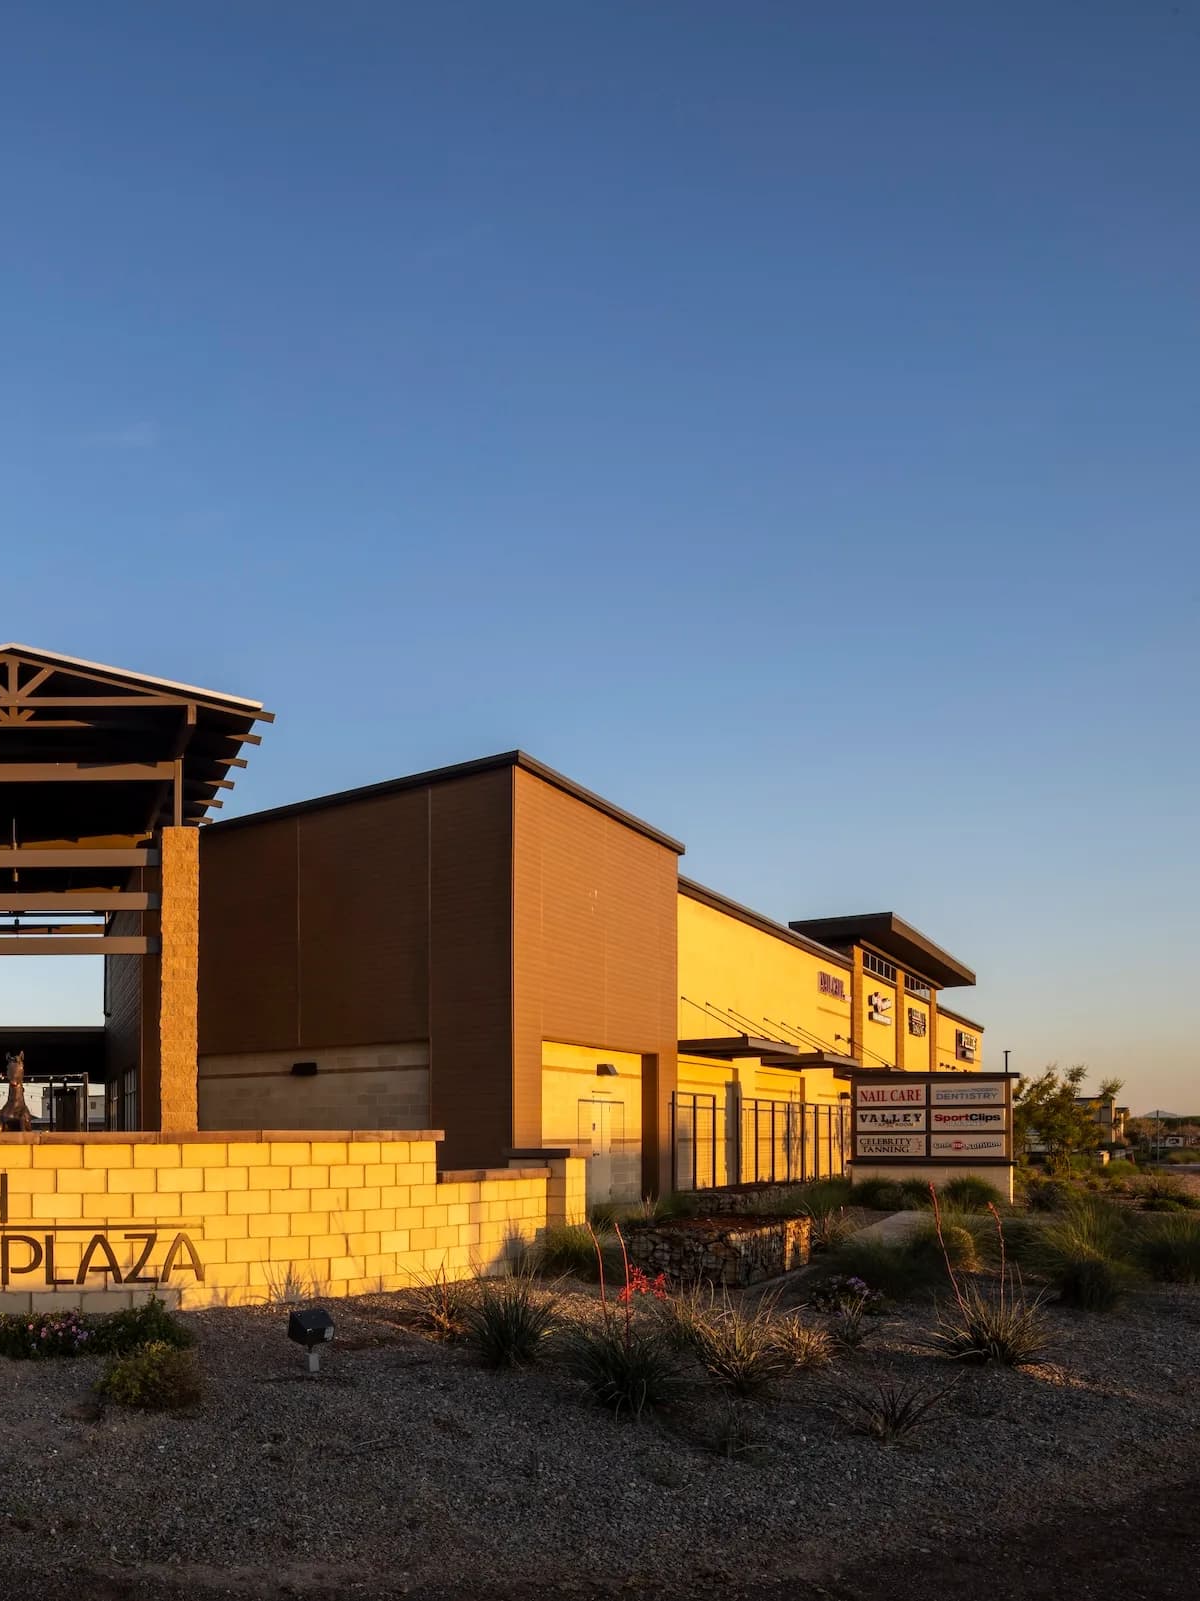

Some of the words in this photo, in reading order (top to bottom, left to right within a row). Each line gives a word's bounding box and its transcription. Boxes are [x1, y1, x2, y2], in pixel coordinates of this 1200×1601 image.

[860, 1090, 887, 1102] NAIL
[890, 1089, 921, 1101] CARE
[936, 1092, 998, 1100] DENTISTRY
[860, 1113, 922, 1123] VALLEY
[1, 1232, 205, 1286] PLAZA
